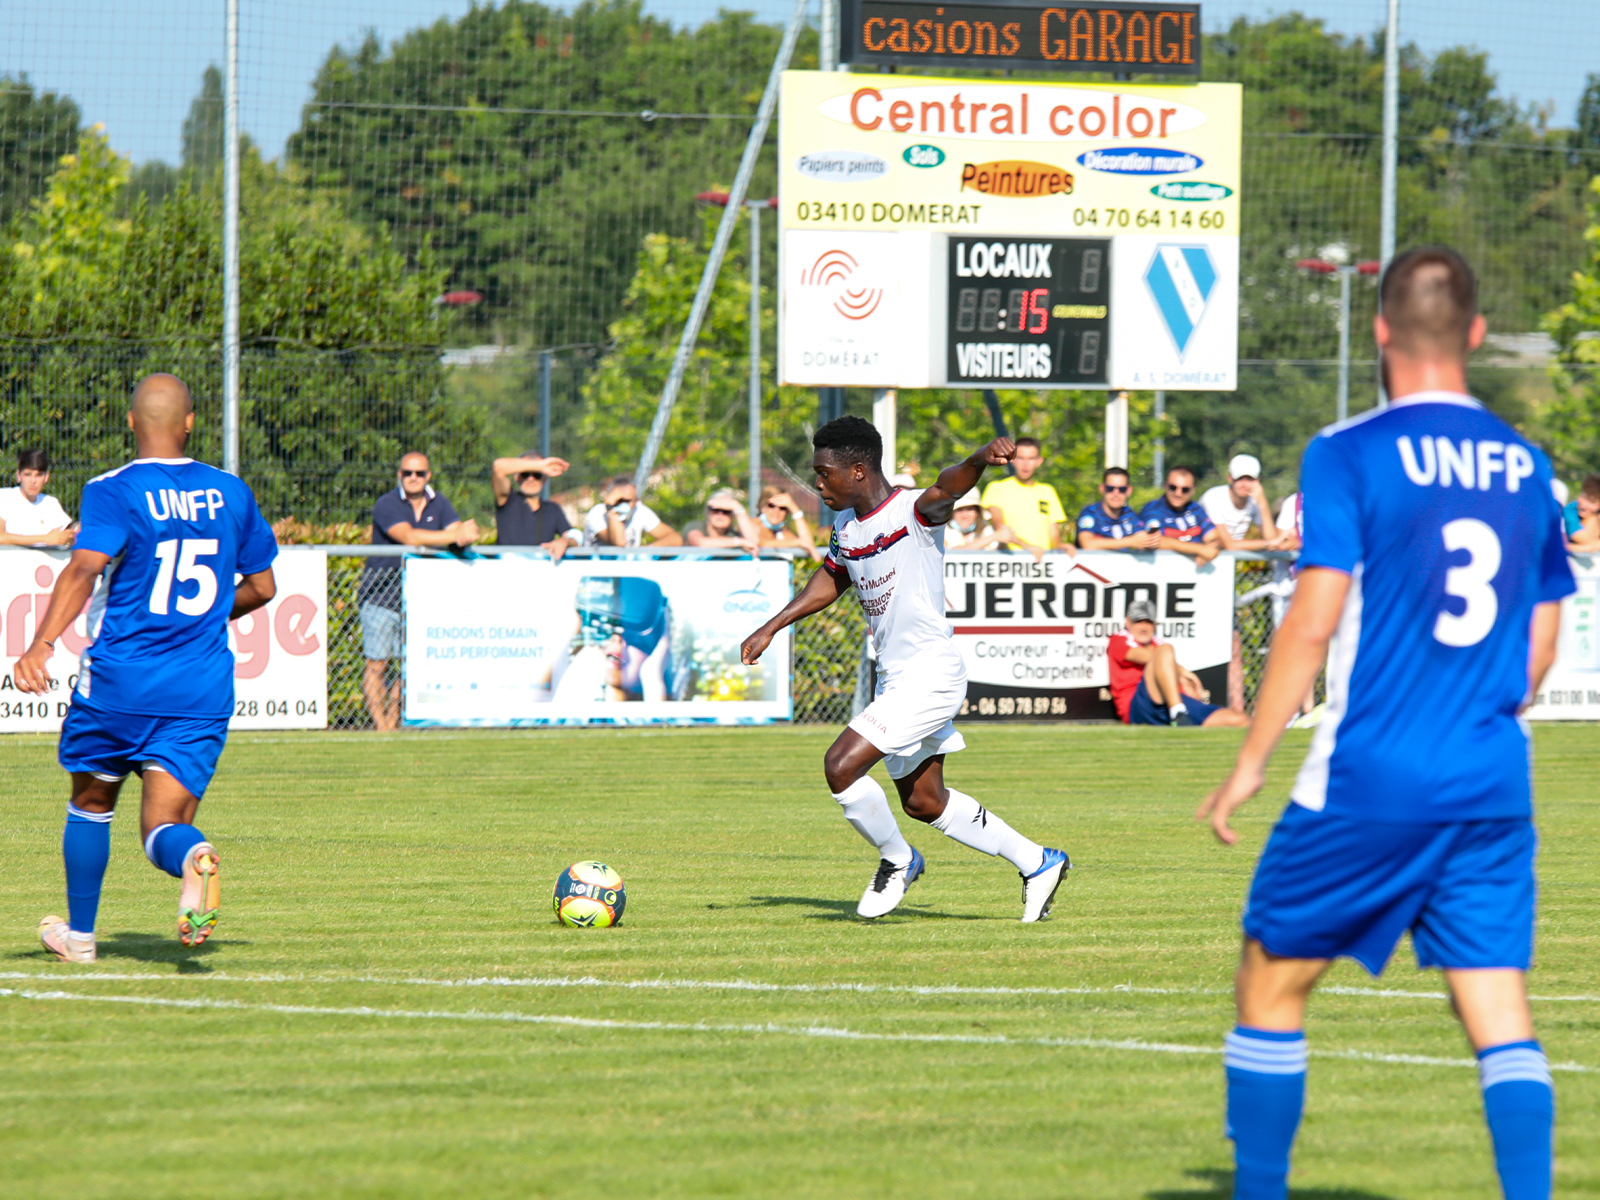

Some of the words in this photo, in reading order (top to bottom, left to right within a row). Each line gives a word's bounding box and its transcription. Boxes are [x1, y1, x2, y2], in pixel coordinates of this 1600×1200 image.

[863, 7, 1021, 56] casions
[850, 87, 1028, 135] Central
[1050, 94, 1177, 139] color
[800, 156, 844, 175] Papiers
[847, 160, 885, 176] peints
[909, 145, 939, 166] Sols
[960, 163, 1074, 195] Peintures
[797, 201, 865, 222] 03410
[872, 202, 982, 224] DOMERAT
[1073, 208, 1098, 226] 04
[1105, 208, 1130, 227] 70
[1136, 209, 1160, 228] 64
[1170, 209, 1192, 228] 14
[1199, 210, 1224, 229] 60
[956, 242, 1053, 278] LOCAUX
[956, 342, 1052, 378] VISITEURS
[1396, 435, 1534, 493] UNFP
[145, 488, 224, 521] UNFP
[149, 538, 218, 616] 15
[868, 567, 896, 591] Mutuel
[945, 562, 1054, 578] NTREPRISE
[1432, 517, 1502, 647] 3
[426, 626, 485, 639] RENDONS
[489, 627, 538, 639] DEMAIN
[1085, 622, 1196, 638] COUVTURE
[426, 646, 457, 659] PLUS
[460, 646, 543, 659] PERFORMANT
[975, 641, 1049, 658] Couvreur
[1066, 641, 1108, 662] Zingu
[1012, 662, 1094, 683] Charpente
[266, 701, 288, 716] 04
[296, 701, 317, 716] 04
